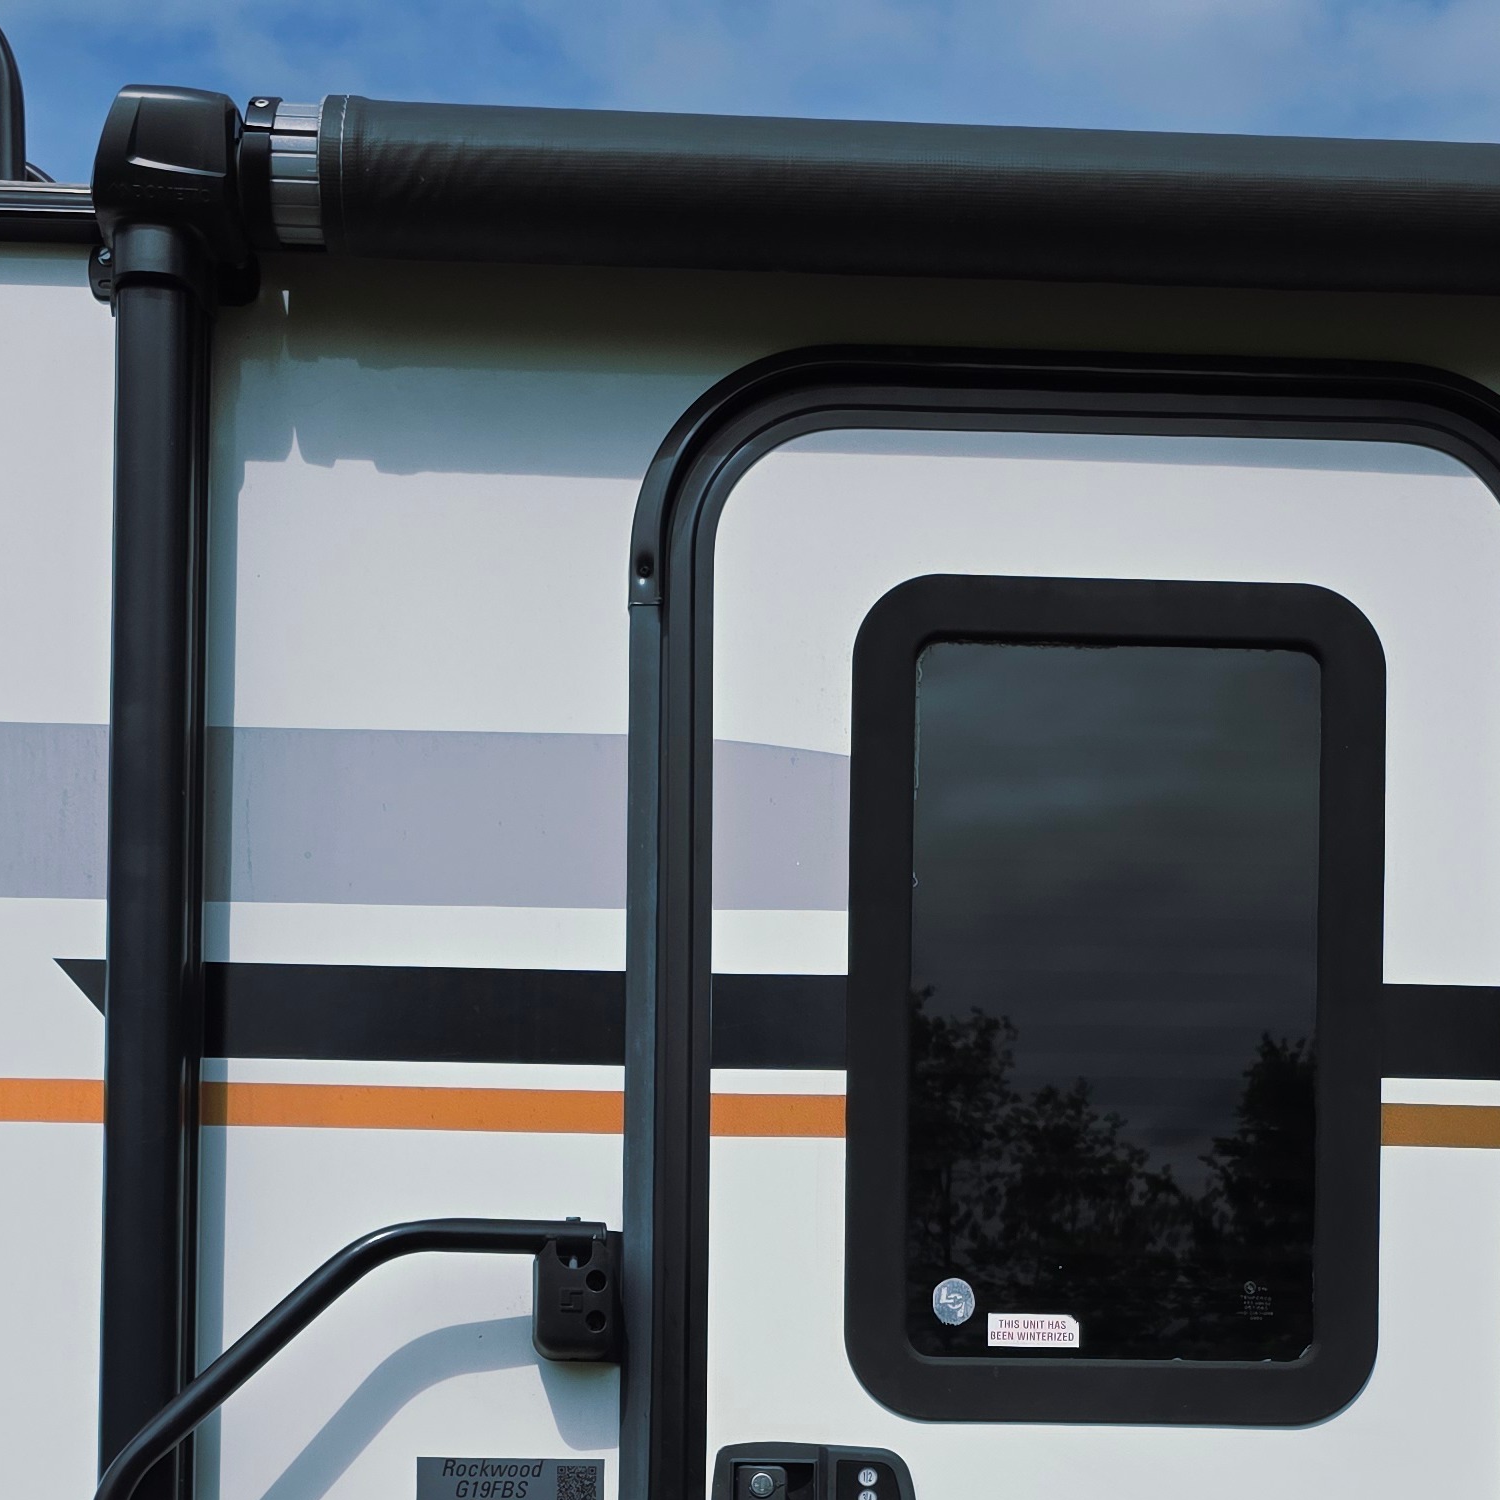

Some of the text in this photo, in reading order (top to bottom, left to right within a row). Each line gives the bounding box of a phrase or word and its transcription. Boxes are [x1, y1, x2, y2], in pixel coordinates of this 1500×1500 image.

[999, 1319, 1067, 1330] THIS UNIT HAS
[990, 1331, 1075, 1342] BEEN WINTERIZED
[442, 1458, 544, 1478] Rockwood
[455, 1480, 529, 1499] G19FBS
